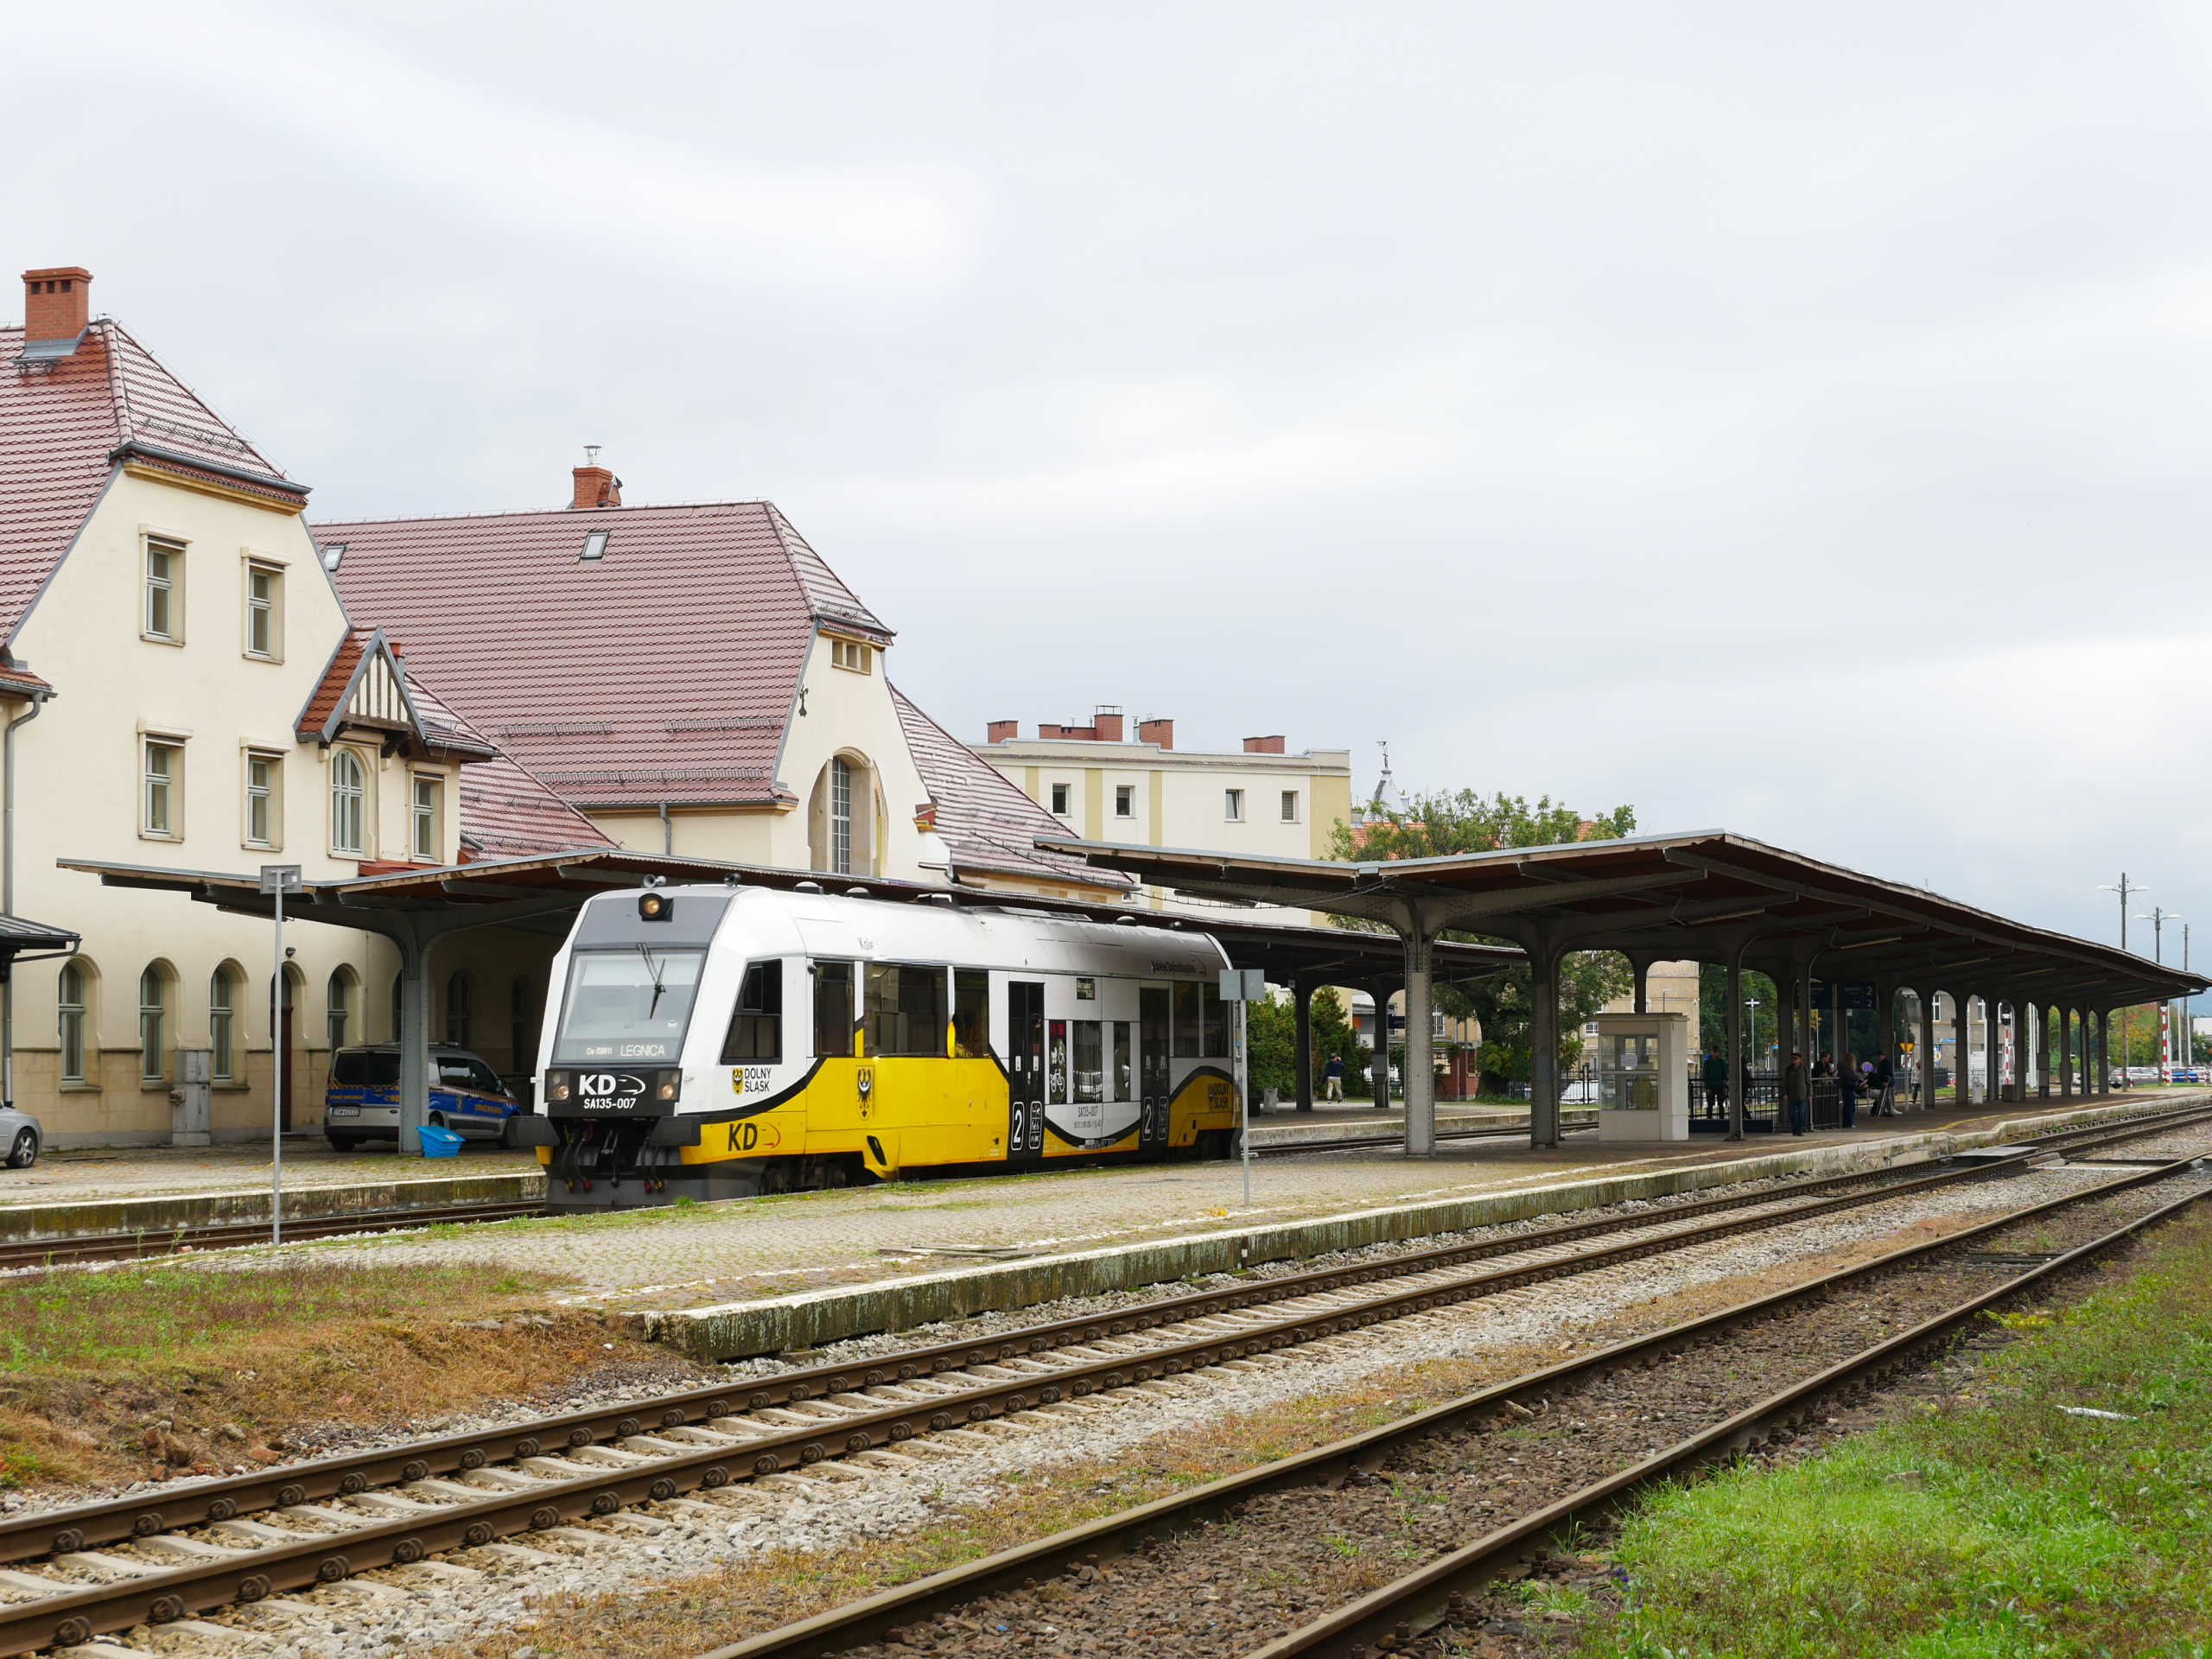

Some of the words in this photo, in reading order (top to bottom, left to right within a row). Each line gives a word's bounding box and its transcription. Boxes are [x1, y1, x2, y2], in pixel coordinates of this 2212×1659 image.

[1866, 987, 1872, 995] 2
[1866, 999, 1872, 1007] 2
[620, 1045, 665, 1056] LEGNICA
[744, 1068, 772, 1079] DOLNY
[578, 1074, 617, 1096] KD
[744, 1077, 770, 1094] ŚLĄSK
[1214, 1084, 1230, 1095] DOLNY
[583, 1098, 637, 1109] SA135-007
[1144, 1103, 1152, 1134] 2
[1013, 1109, 1022, 1143] 2
[728, 1122, 758, 1151] KD
